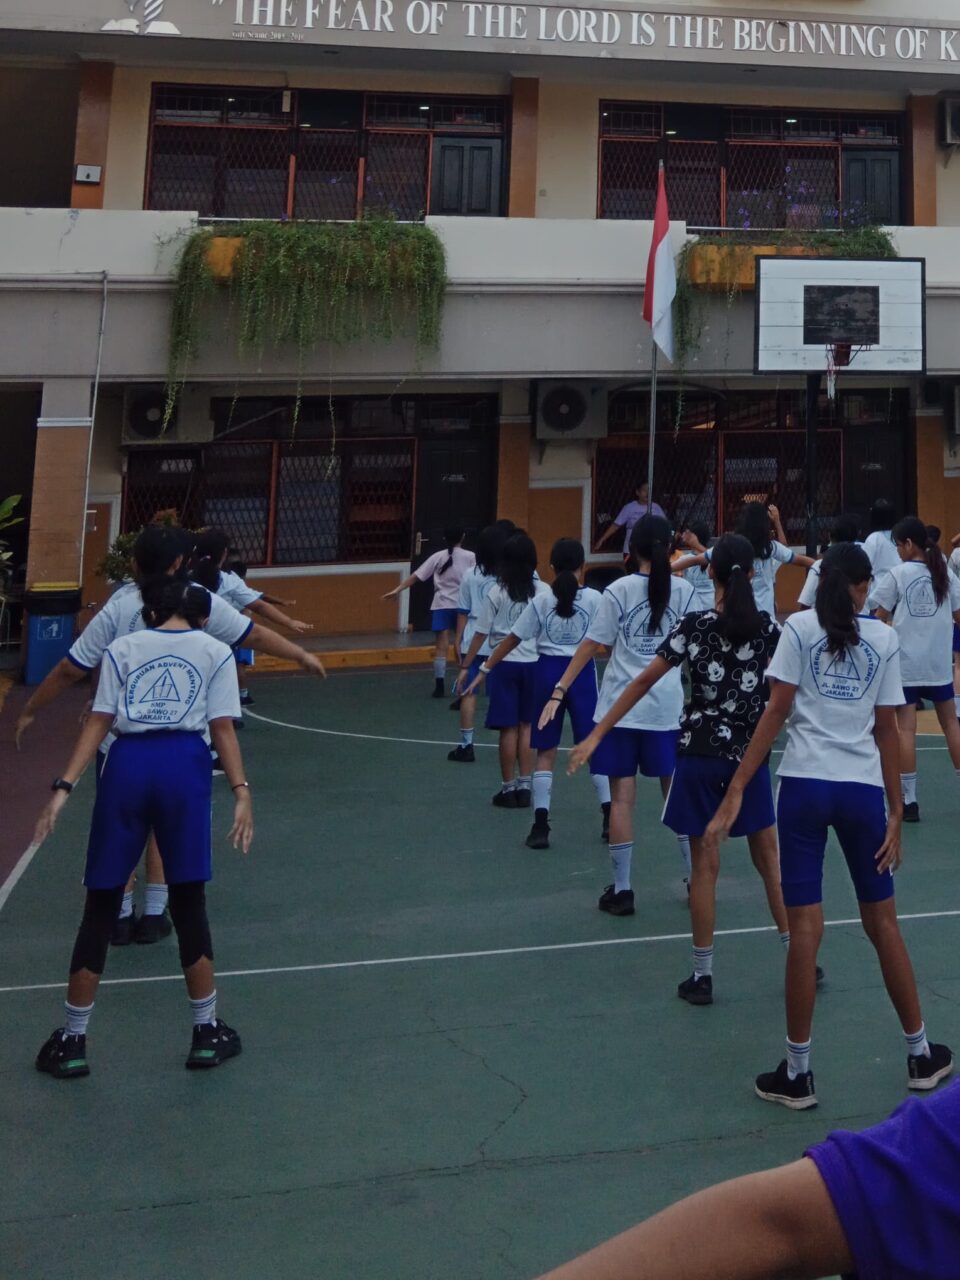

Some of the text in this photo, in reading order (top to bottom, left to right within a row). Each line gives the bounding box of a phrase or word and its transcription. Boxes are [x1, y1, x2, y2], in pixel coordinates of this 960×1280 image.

[406, 0, 448, 35] OF
[462, 3, 528, 39] THE
[537, 7, 621, 44] LORD
[629, 12, 656, 47] IS
[663, 15, 724, 49] THE
[733, 18, 887, 58] BEGINNING
[895, 27, 929, 59] OF
[128, 662, 196, 705] PERGURUAN ADVENT MENTENG
[825, 689, 854, 697] JAKARTA
